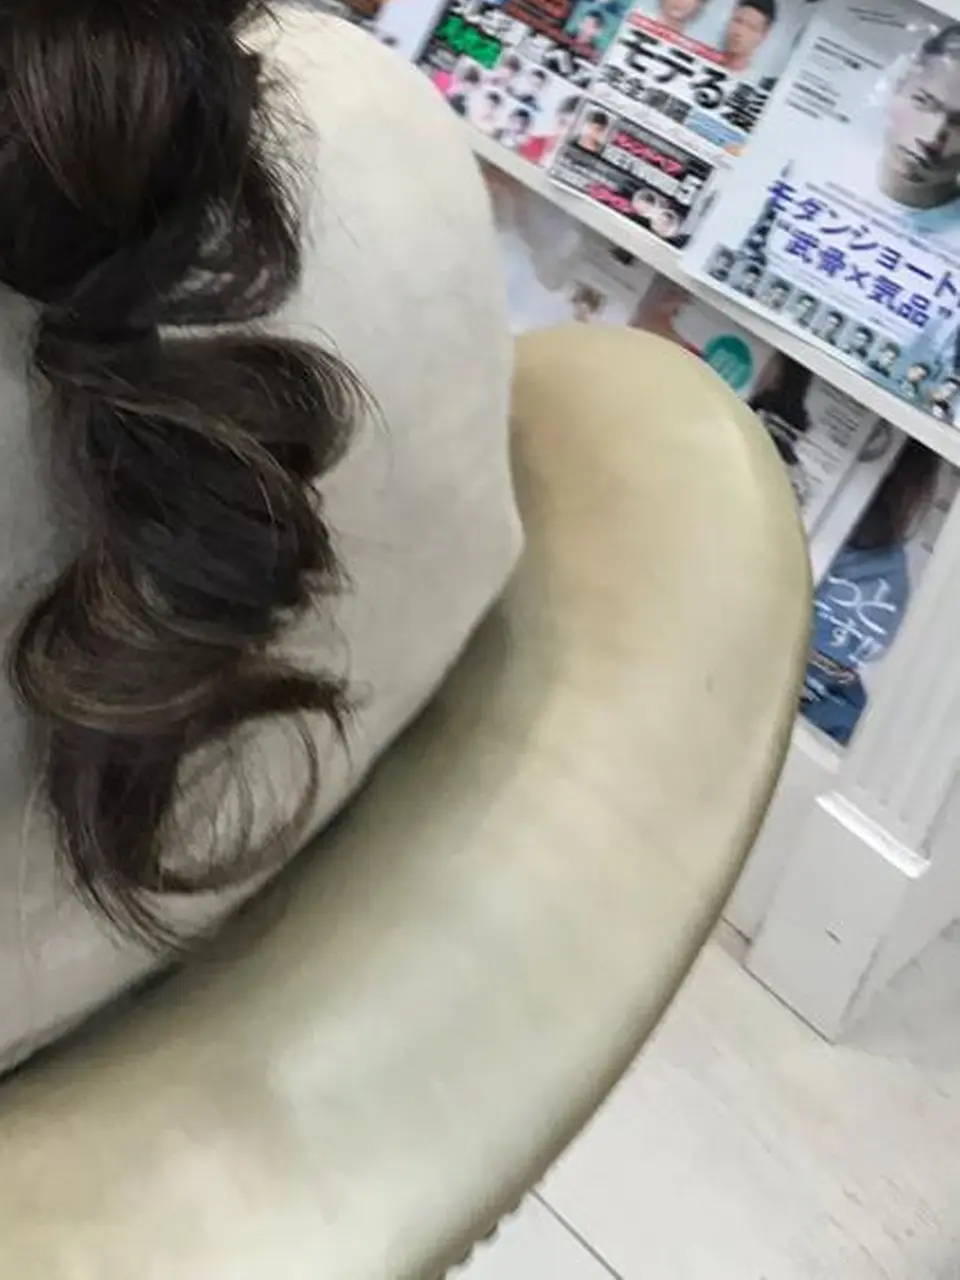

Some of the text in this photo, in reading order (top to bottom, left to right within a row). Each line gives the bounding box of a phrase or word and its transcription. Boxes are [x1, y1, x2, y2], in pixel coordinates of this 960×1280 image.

[768, 180, 958, 298] モダンショート
